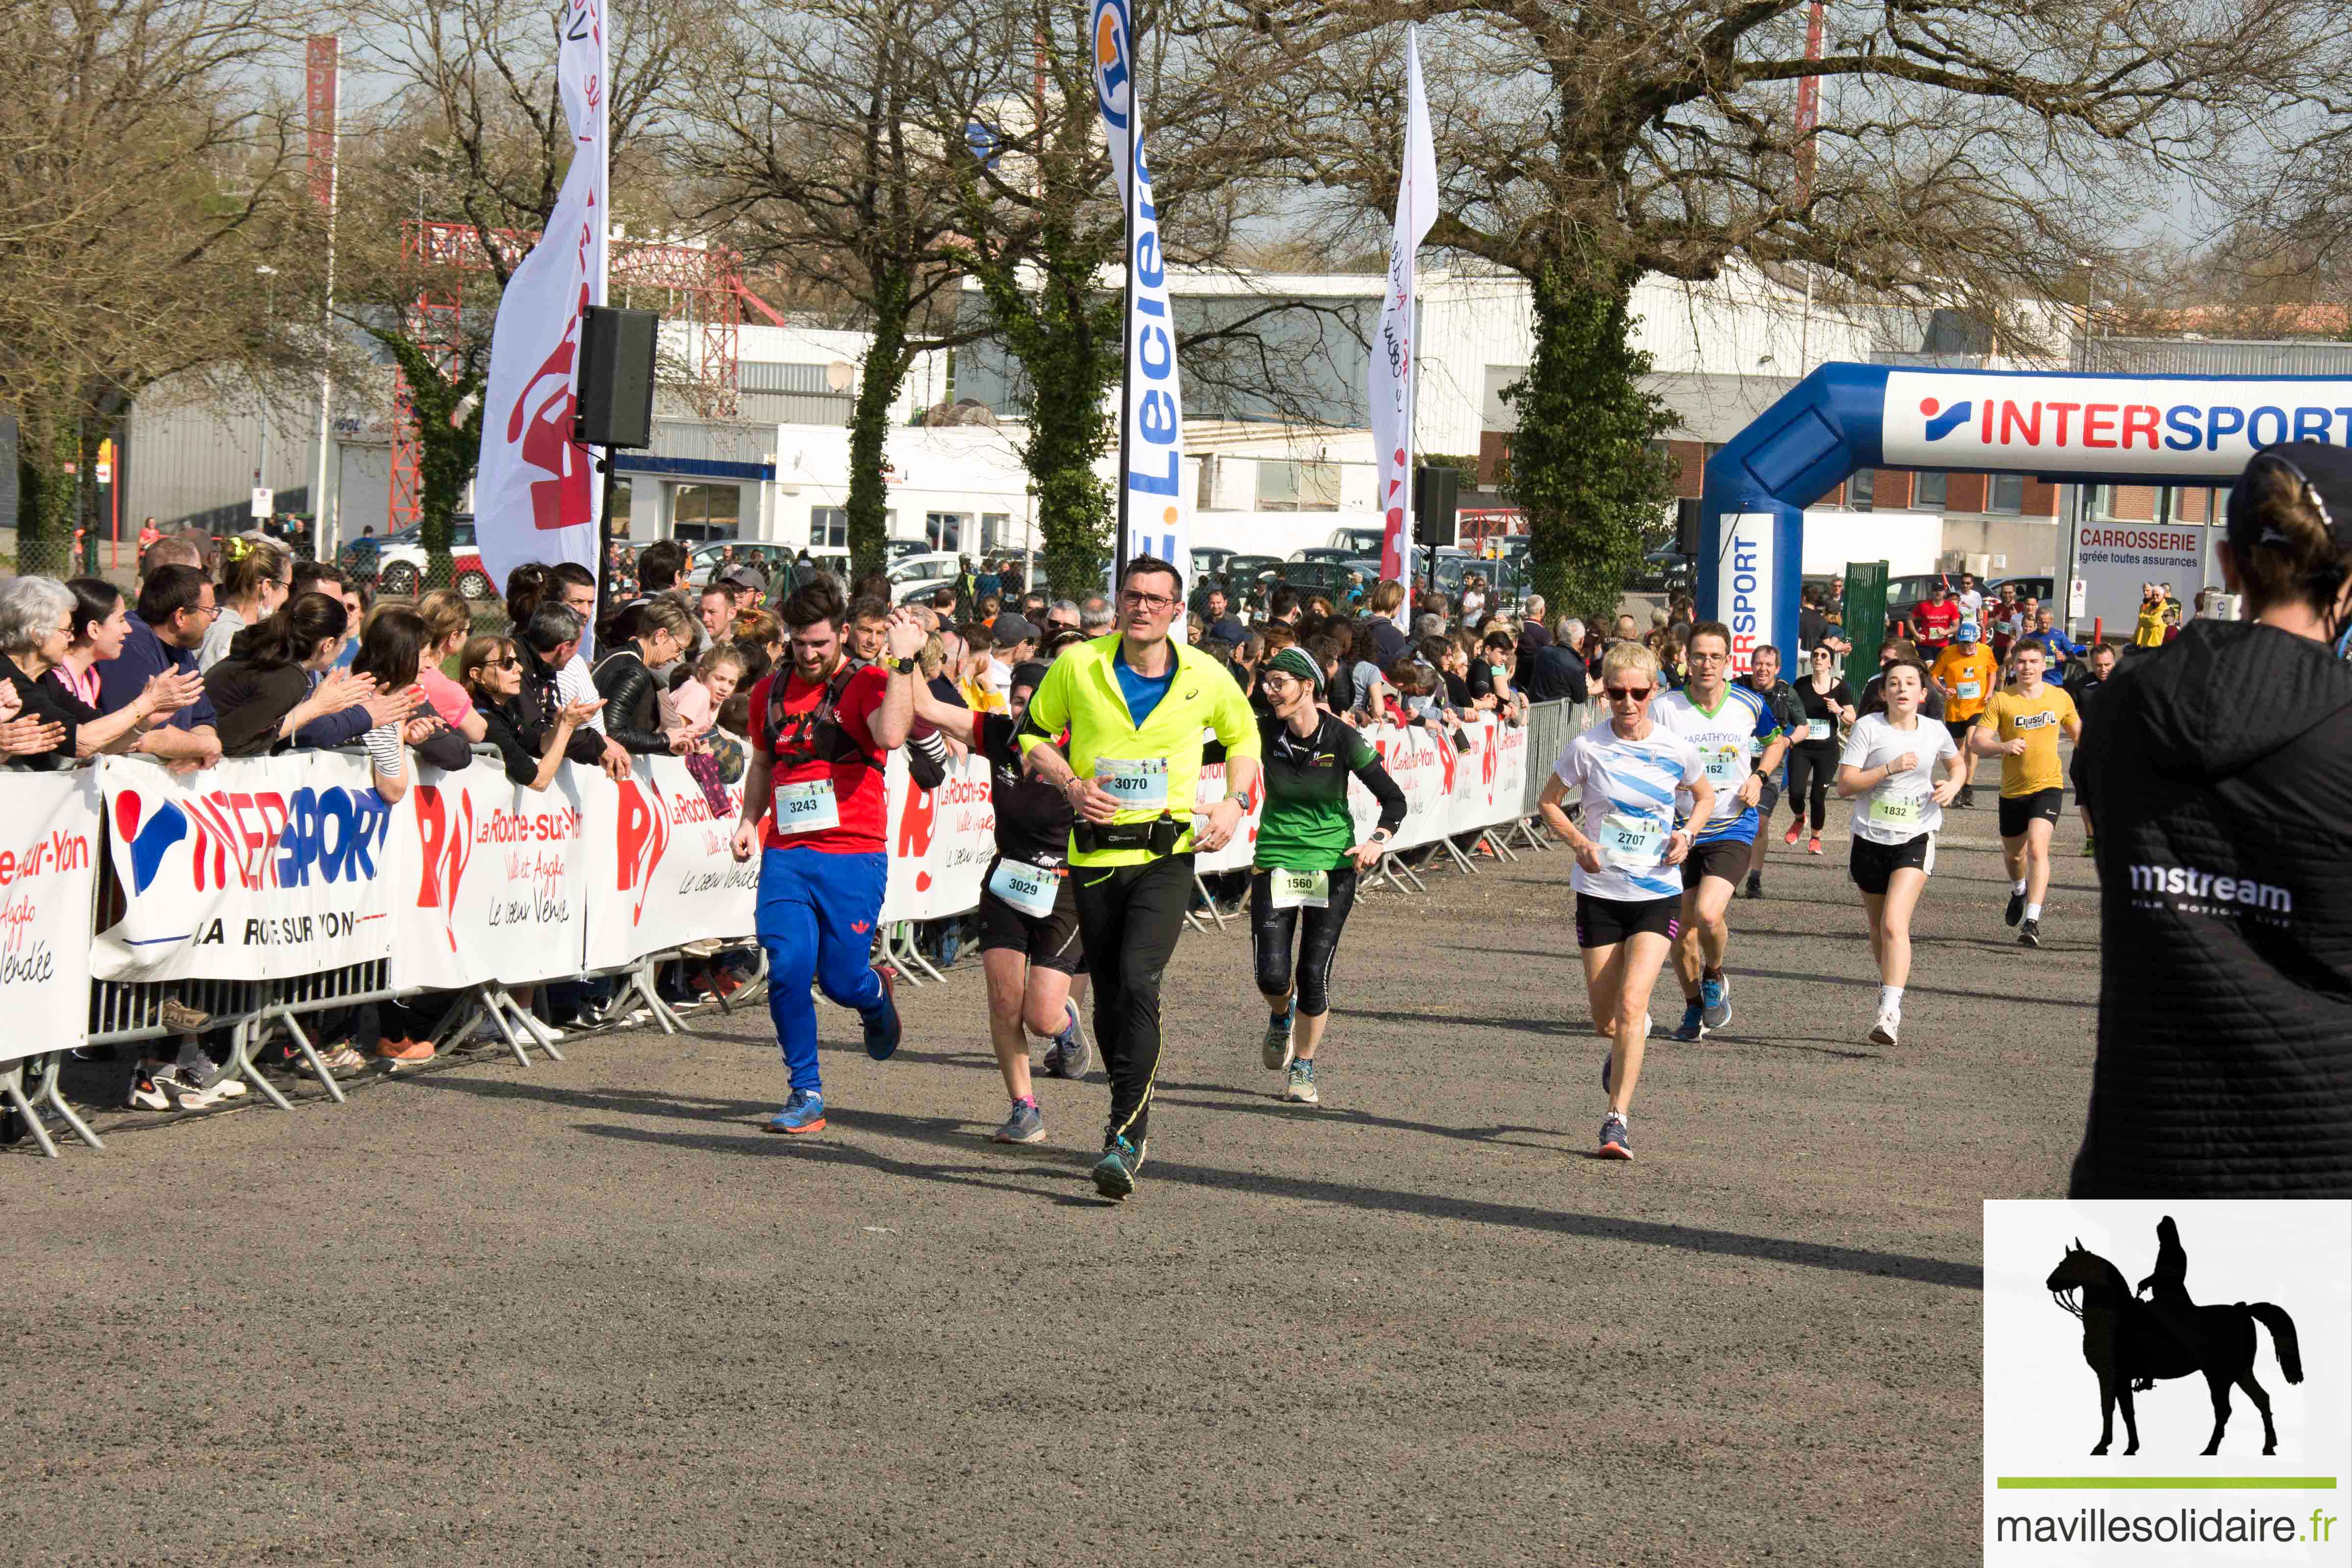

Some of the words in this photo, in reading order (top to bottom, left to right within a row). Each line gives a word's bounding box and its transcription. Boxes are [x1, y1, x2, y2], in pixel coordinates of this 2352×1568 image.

[2081, 529, 2196, 552] CARROSSERIE
[2111, 552, 2140, 564] toutes
[2142, 555, 2198, 567] assurances
[1733, 536, 1756, 679] ERSPORT
[1685, 733, 1741, 744] ARATH'YON
[1704, 765, 1722, 774] 162
[1114, 778, 1148, 790] 3070
[789, 799, 817, 813] 3243
[1885, 806, 1907, 816] 1832
[1617, 832, 1645, 846] 2707
[1009, 878, 1038, 895] 3029
[1286, 879, 1312, 888] 1560
[2129, 864, 2292, 913] mstream
[282, 916, 313, 944] SUR
[319, 911, 354, 938] YON
